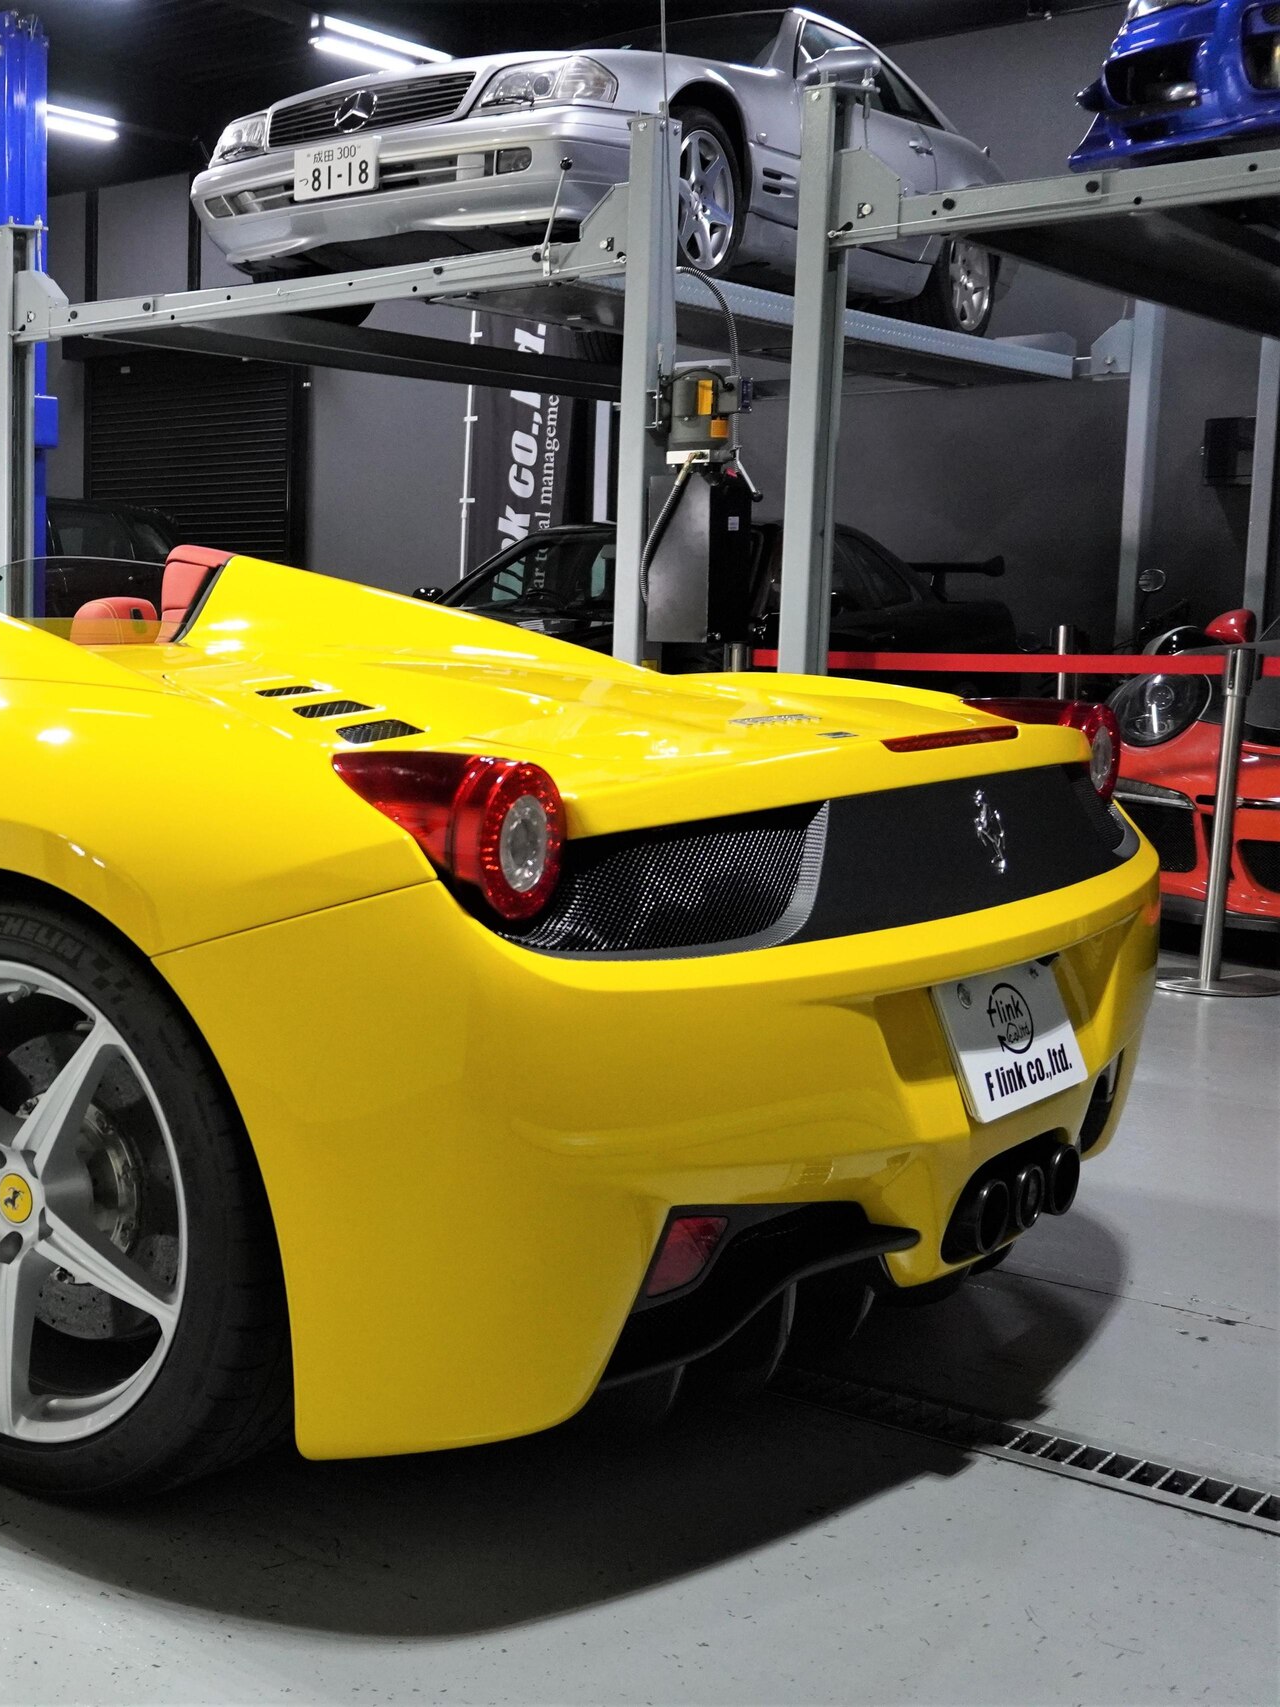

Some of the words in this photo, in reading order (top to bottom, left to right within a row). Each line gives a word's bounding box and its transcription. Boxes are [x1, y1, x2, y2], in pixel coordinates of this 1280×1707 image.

[313, 149, 334, 164] 成田
[336, 144, 357, 160] 300
[311, 159, 369, 192] 81-18
[540, 394, 560, 506] manageme
[984, 1071, 995, 1102] F
[995, 1060, 1027, 1098] link
